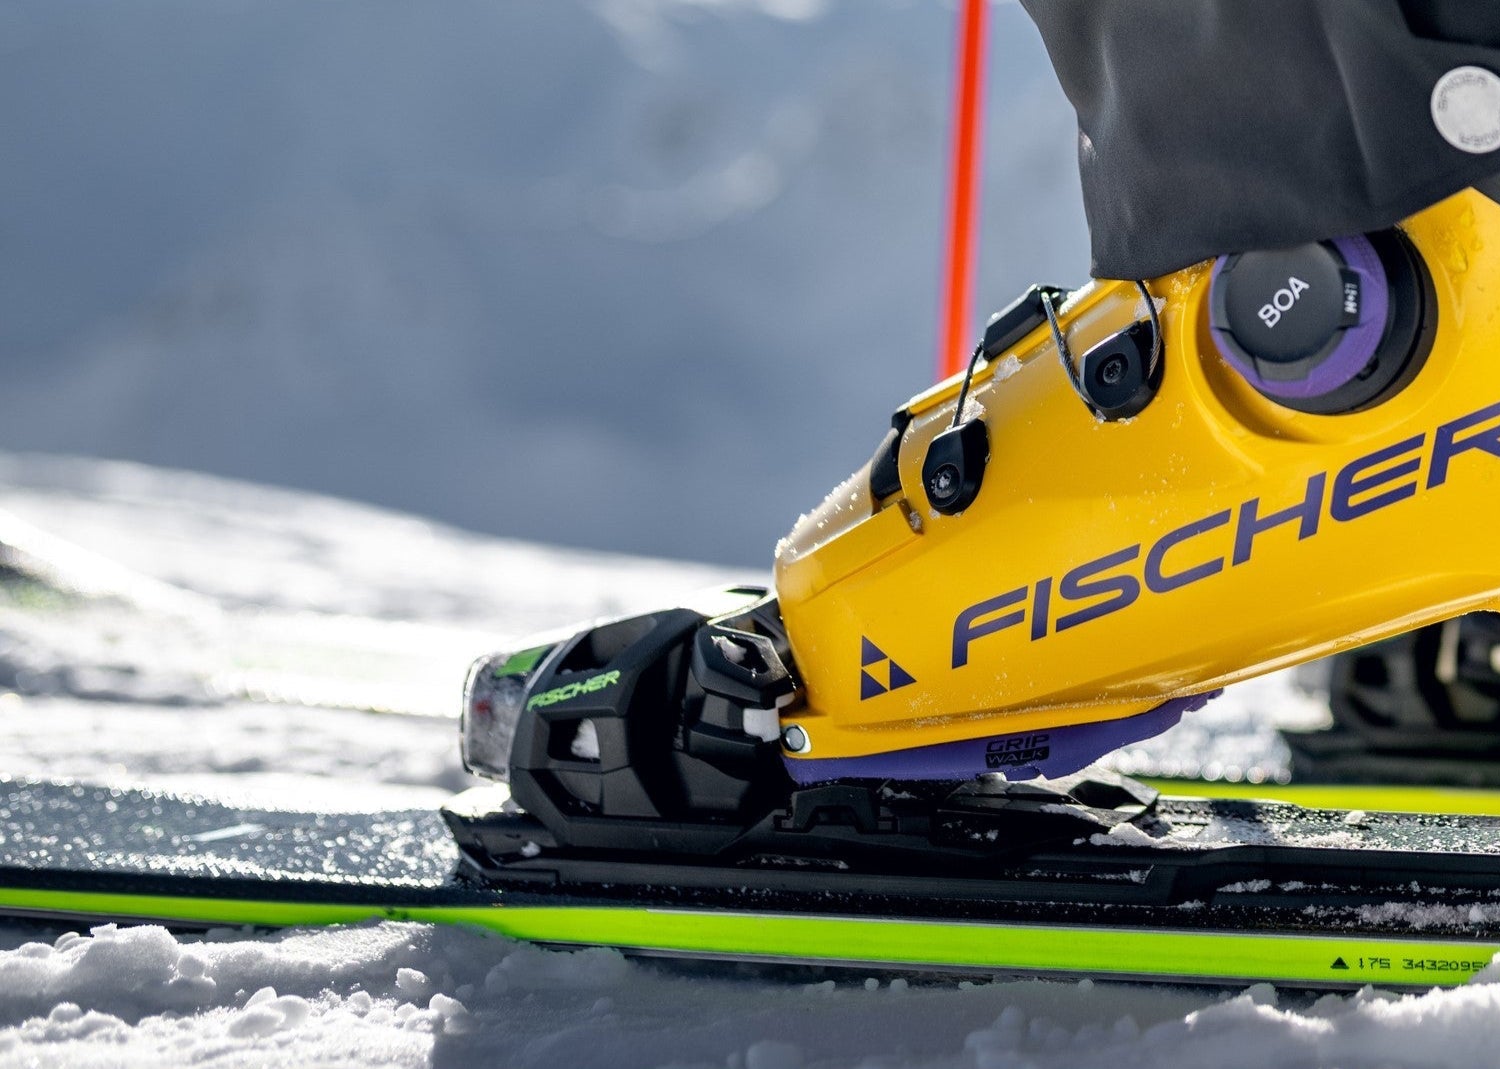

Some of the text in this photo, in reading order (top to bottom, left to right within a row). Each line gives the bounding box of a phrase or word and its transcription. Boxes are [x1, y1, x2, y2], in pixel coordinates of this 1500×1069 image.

[1258, 277, 1310, 328] BOA
[527, 670, 621, 711] FISCHER
[986, 735, 1049, 752] GRIP
[987, 750, 1044, 764] WALK
[1358, 957, 1391, 970] 175
